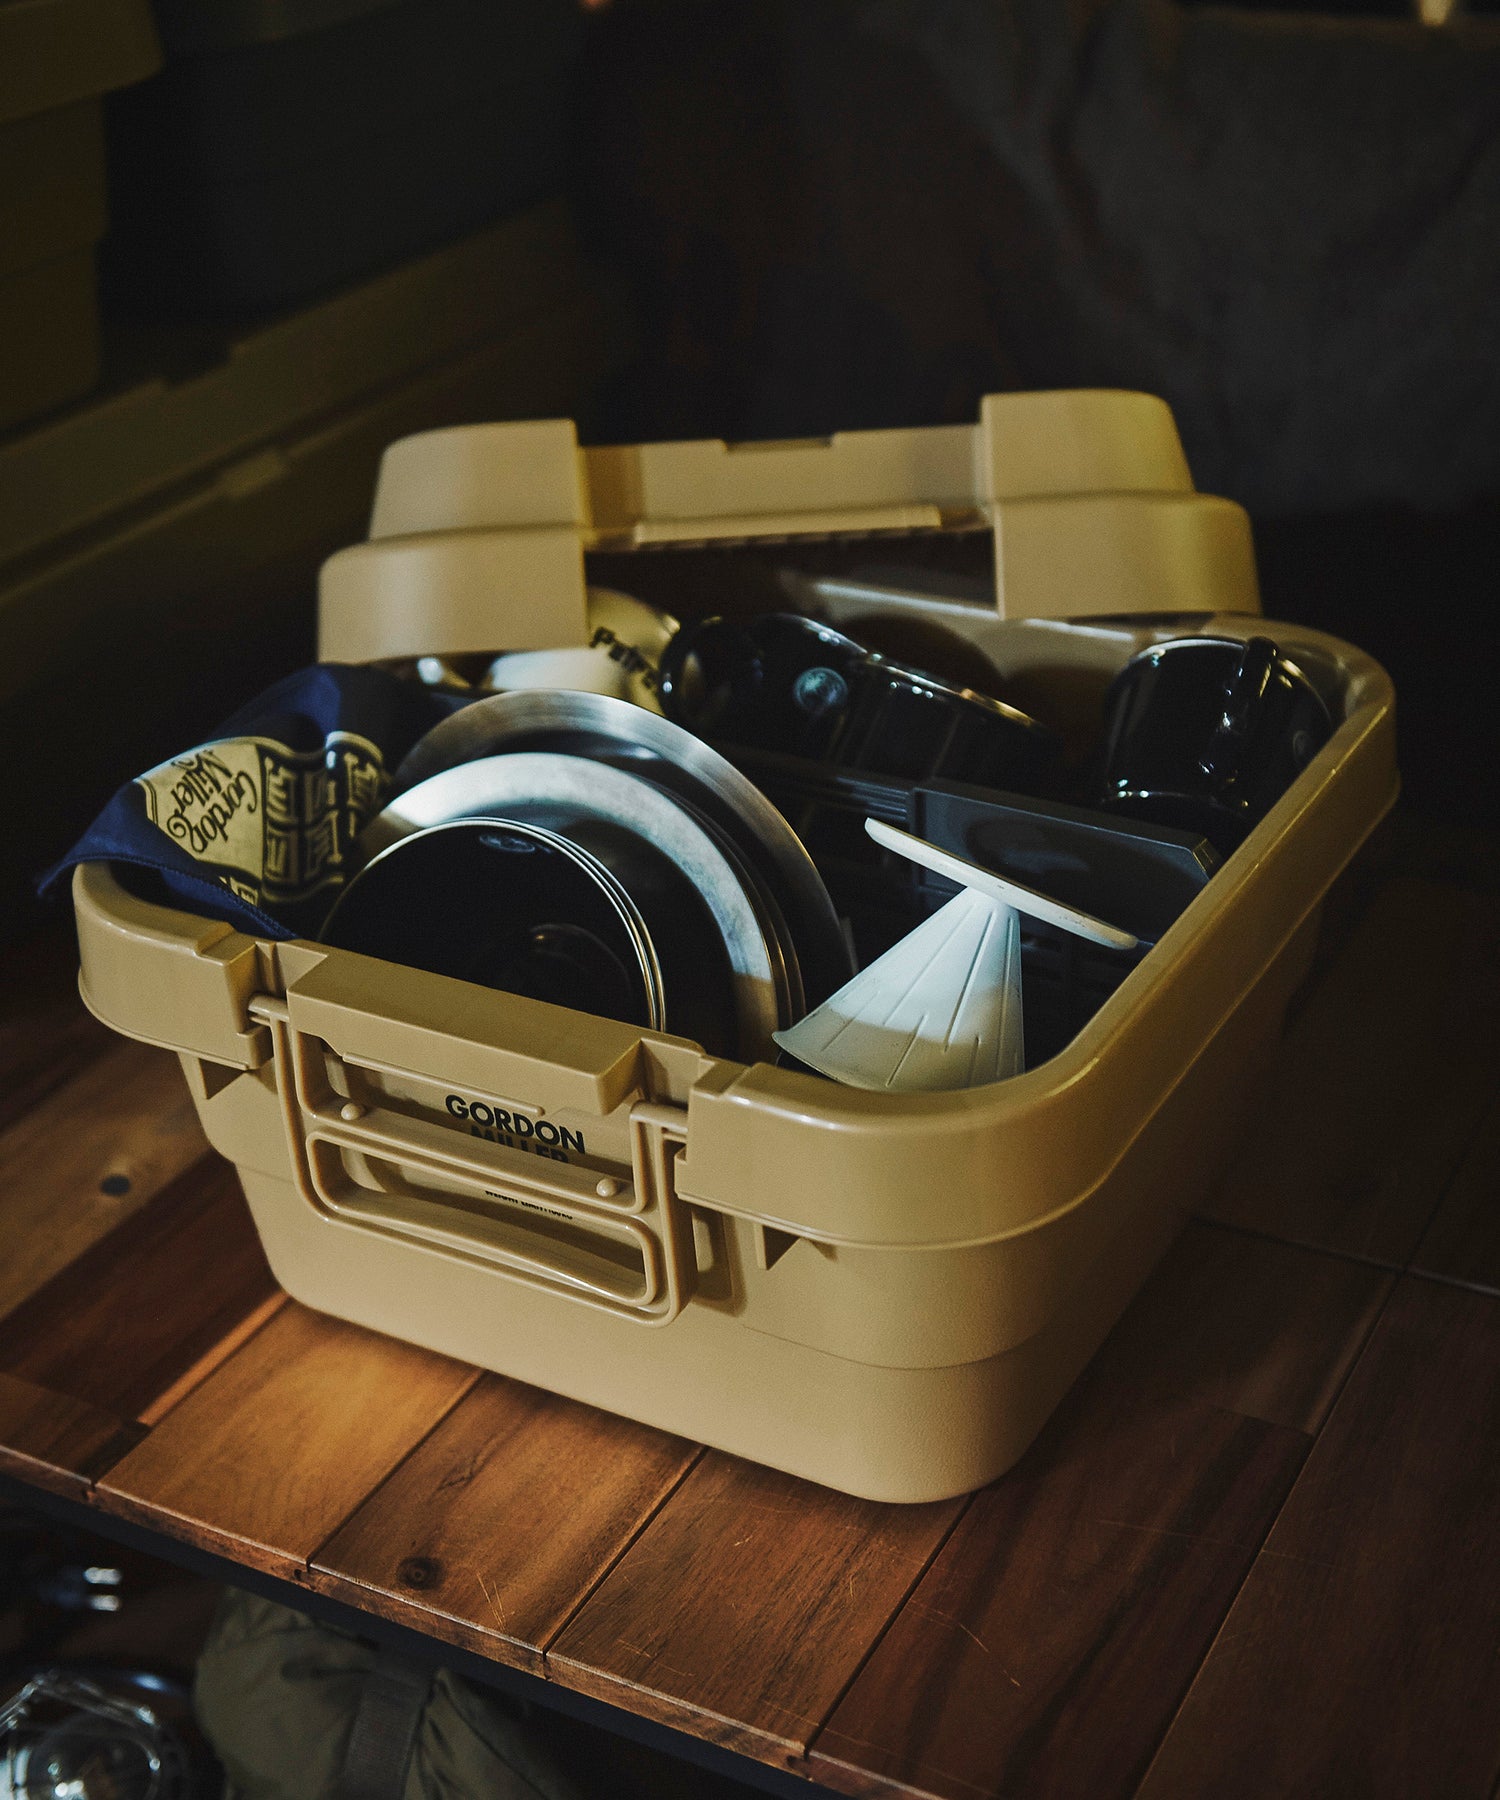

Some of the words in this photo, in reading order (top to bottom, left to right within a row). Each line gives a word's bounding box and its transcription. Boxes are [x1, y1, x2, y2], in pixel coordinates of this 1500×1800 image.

[166, 770, 257, 853] Gordon
[170, 750, 233, 814] Miller
[445, 1094, 586, 1155] GORDON
